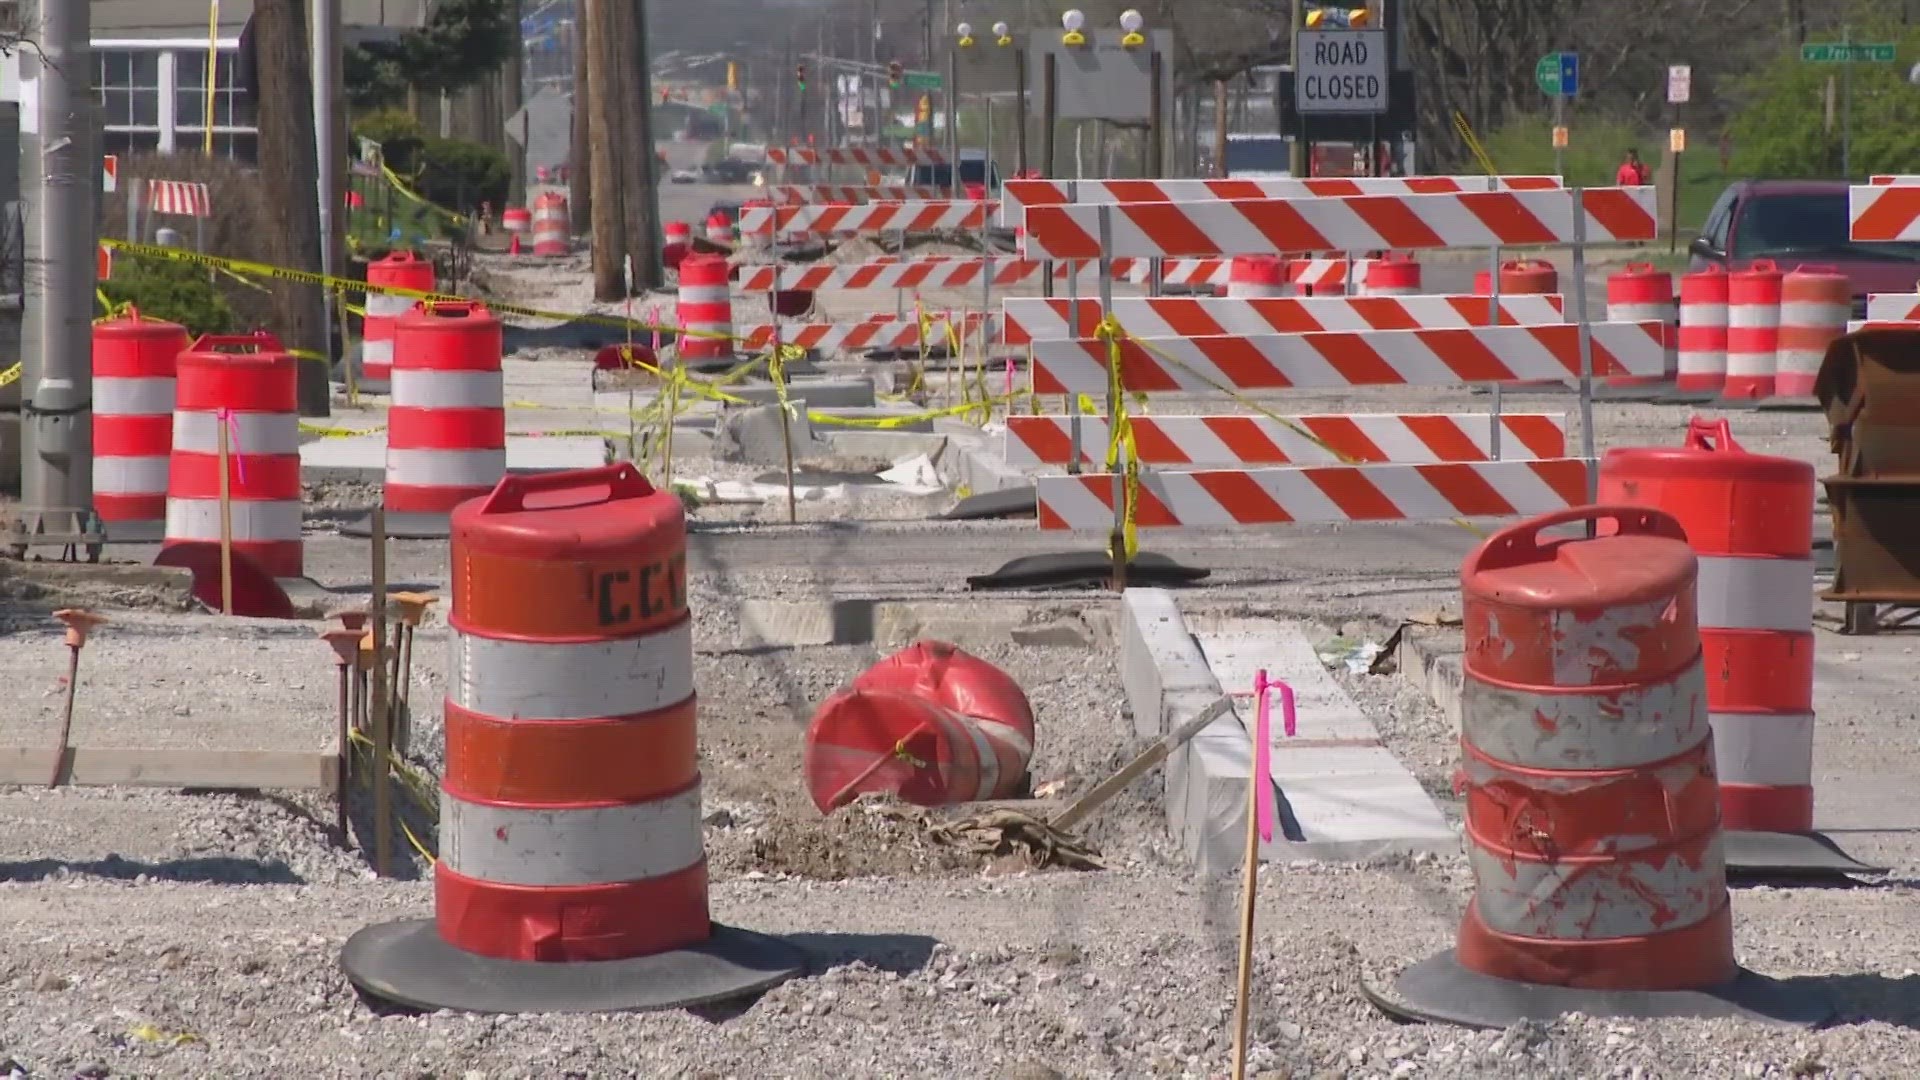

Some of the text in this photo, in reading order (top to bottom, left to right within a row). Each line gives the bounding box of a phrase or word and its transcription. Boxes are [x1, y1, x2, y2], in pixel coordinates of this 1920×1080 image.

[1315, 41, 1367, 65] ROAD
[1305, 75, 1379, 99] CLOSED
[179, 253, 230, 269] CAUTION
